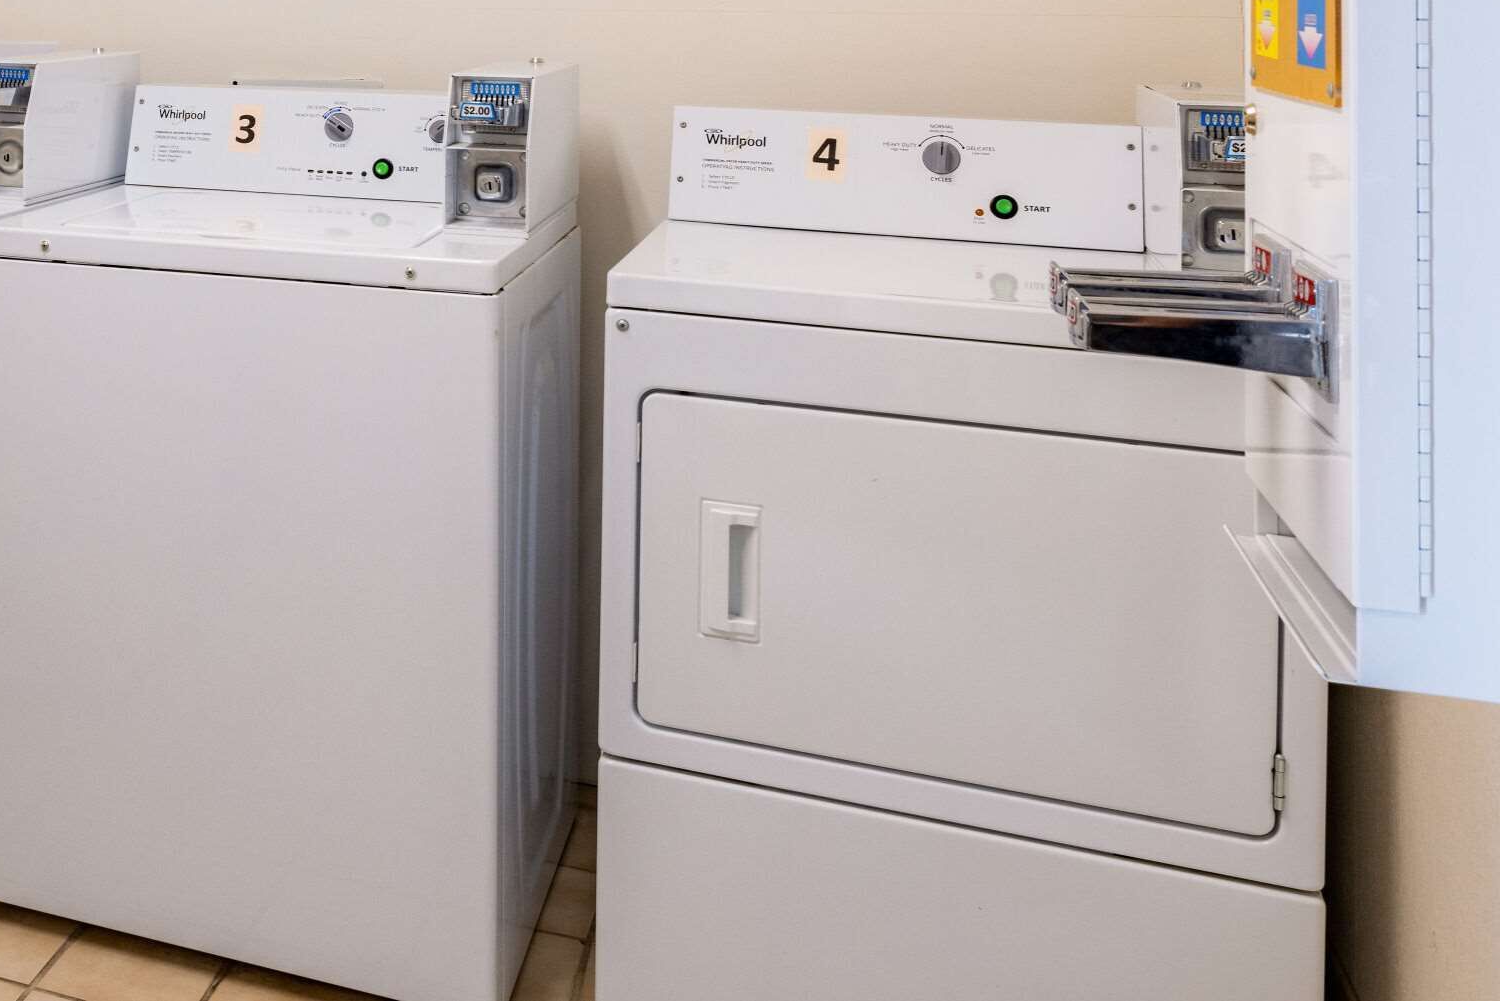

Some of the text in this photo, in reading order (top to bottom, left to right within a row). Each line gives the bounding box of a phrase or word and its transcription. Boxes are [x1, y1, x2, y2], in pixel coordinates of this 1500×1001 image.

[159, 108, 206, 122] Whirlpool
[463, 106, 491, 116] $2.00
[235, 114, 256, 144] 3
[706, 132, 767, 149] Whirlpool
[812, 137, 840, 171] 4
[1024, 205, 1051, 213] START
